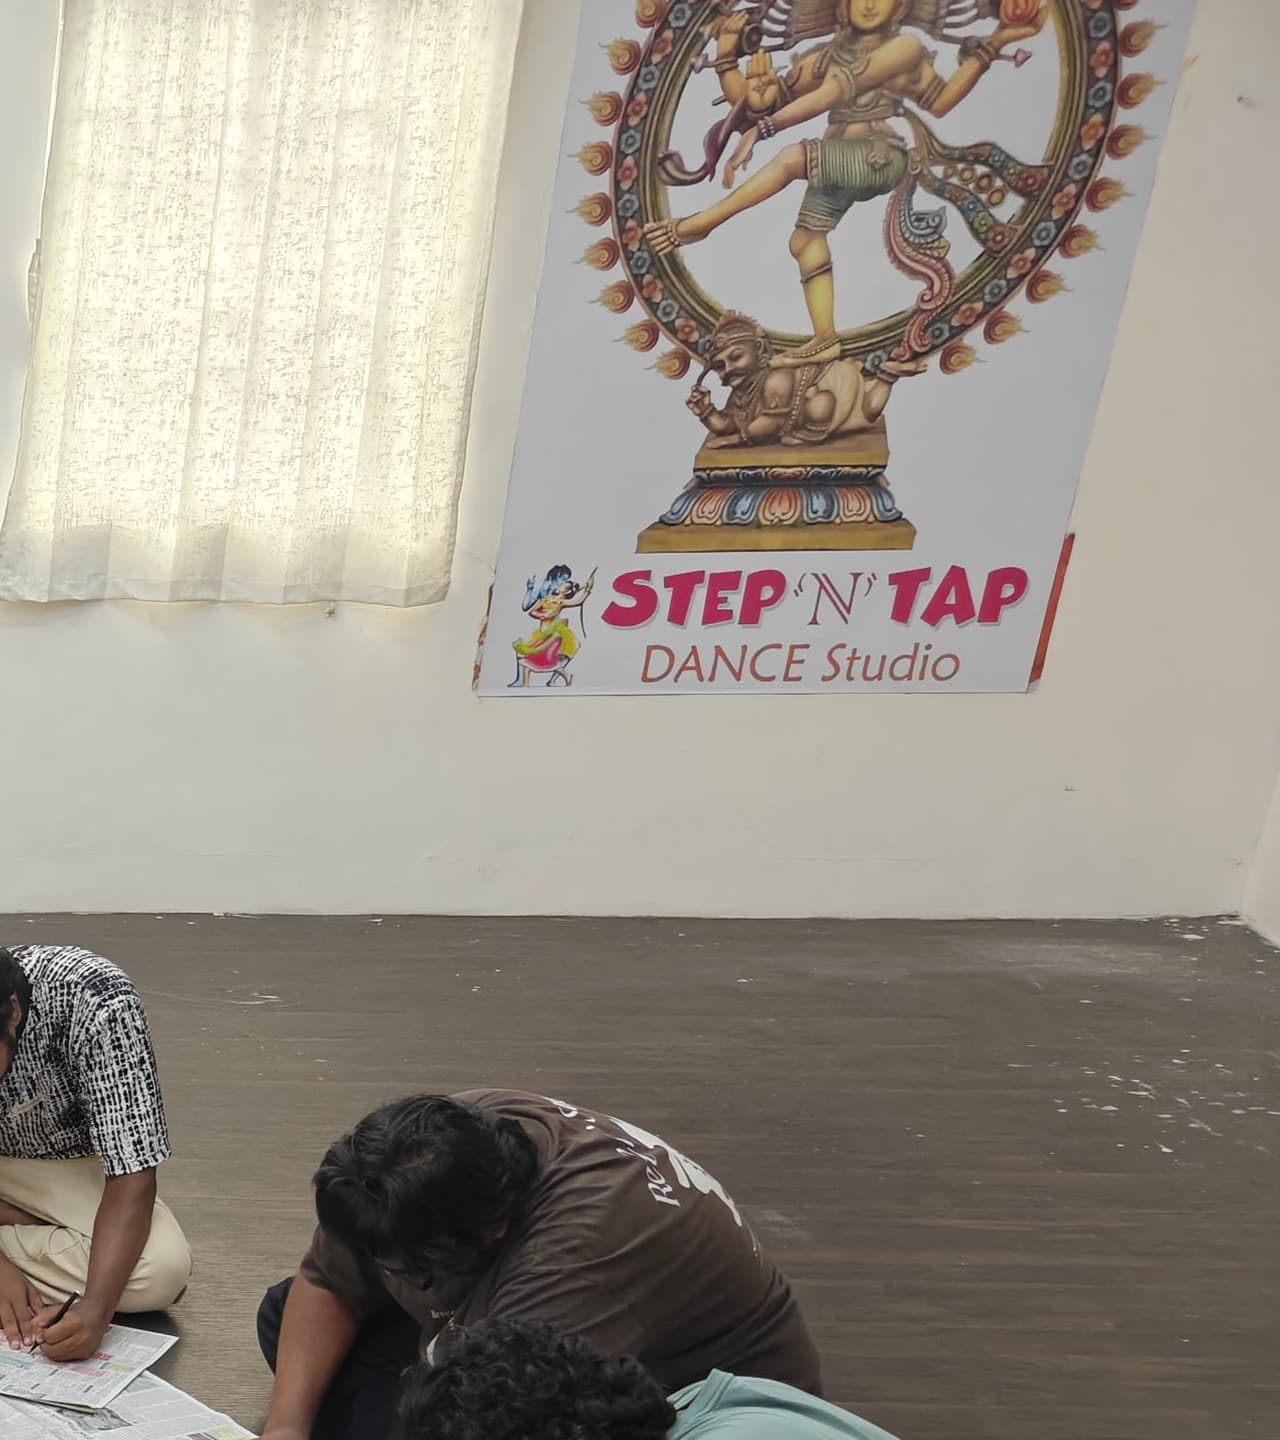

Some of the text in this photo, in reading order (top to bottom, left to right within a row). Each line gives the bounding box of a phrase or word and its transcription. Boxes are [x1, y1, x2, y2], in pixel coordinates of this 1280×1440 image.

[600, 567, 789, 630] STEP
[887, 565, 1029, 630] TAP
[640, 642, 961, 684] DANCE Studio
